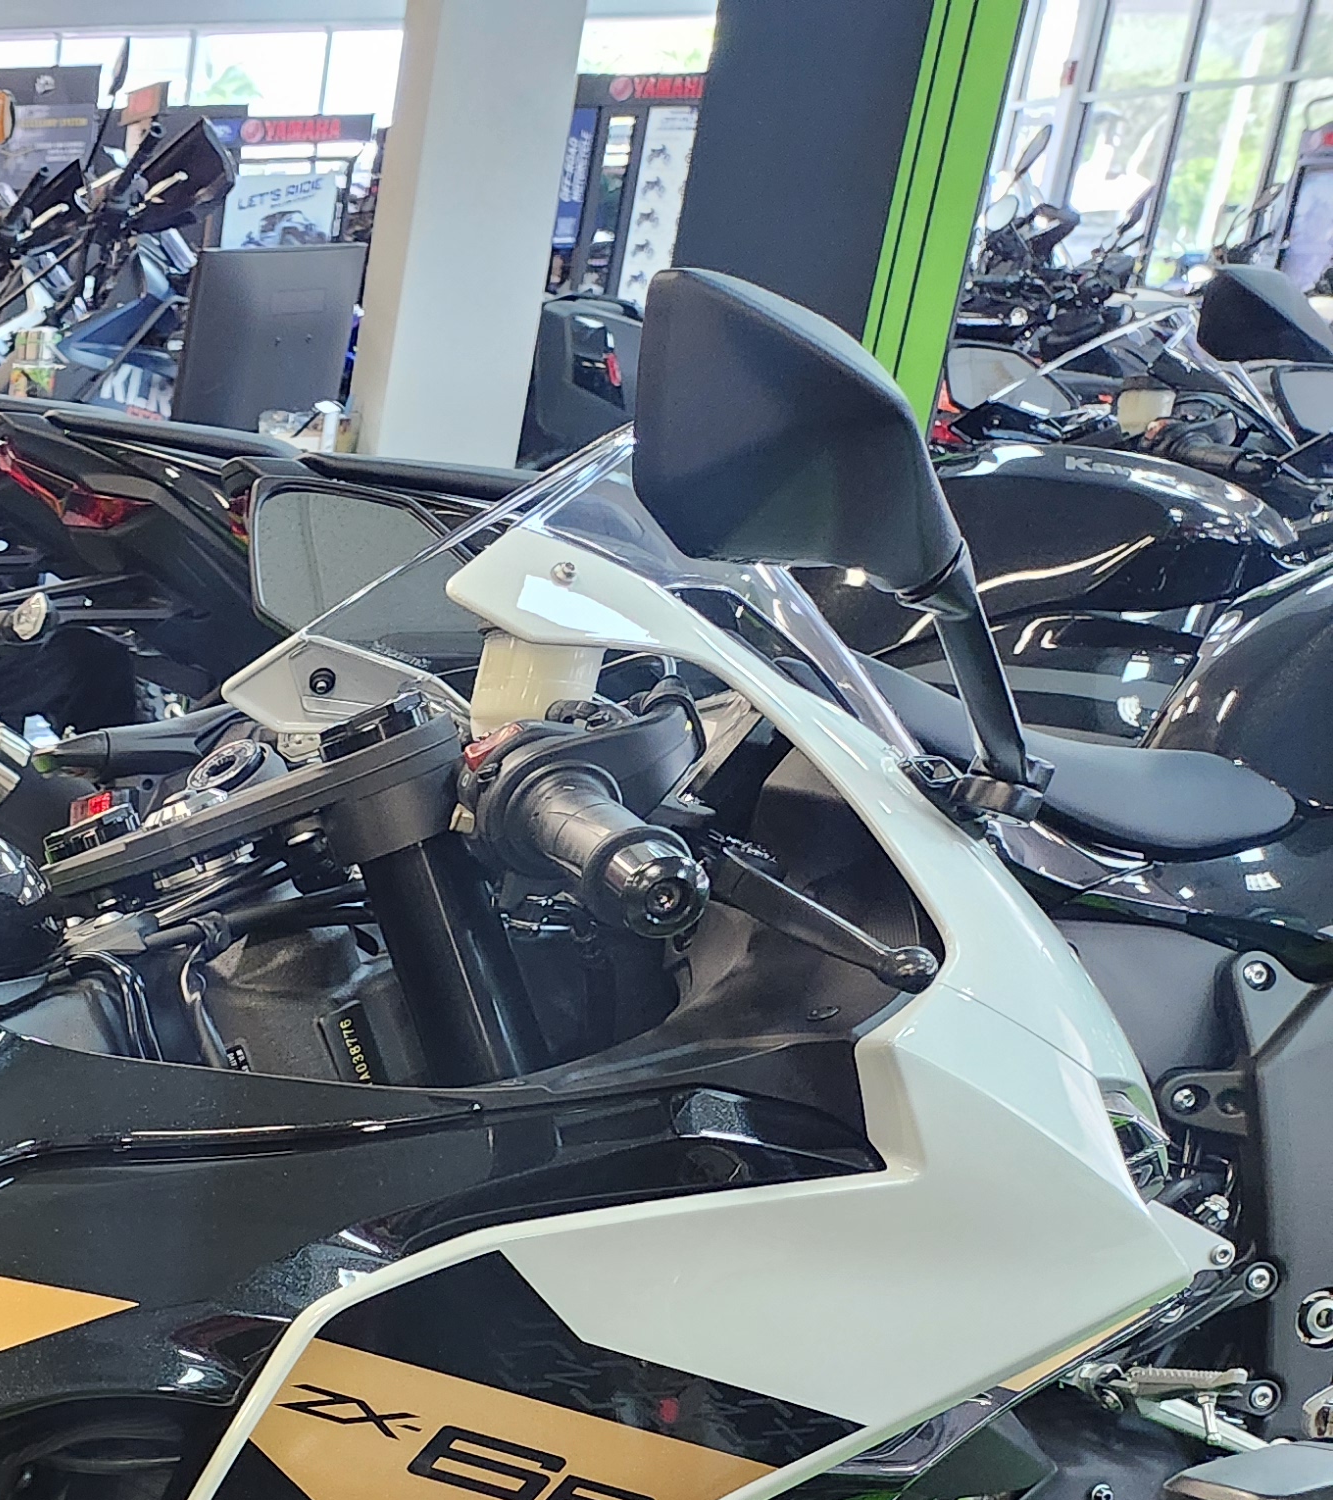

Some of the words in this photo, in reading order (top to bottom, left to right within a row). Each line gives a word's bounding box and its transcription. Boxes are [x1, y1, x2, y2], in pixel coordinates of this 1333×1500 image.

[265, 118, 341, 141] YAMAHA
[237, 189, 282, 210] LET'S
[100, 363, 173, 418] KLR
[340, 1018, 373, 1085] A038776
